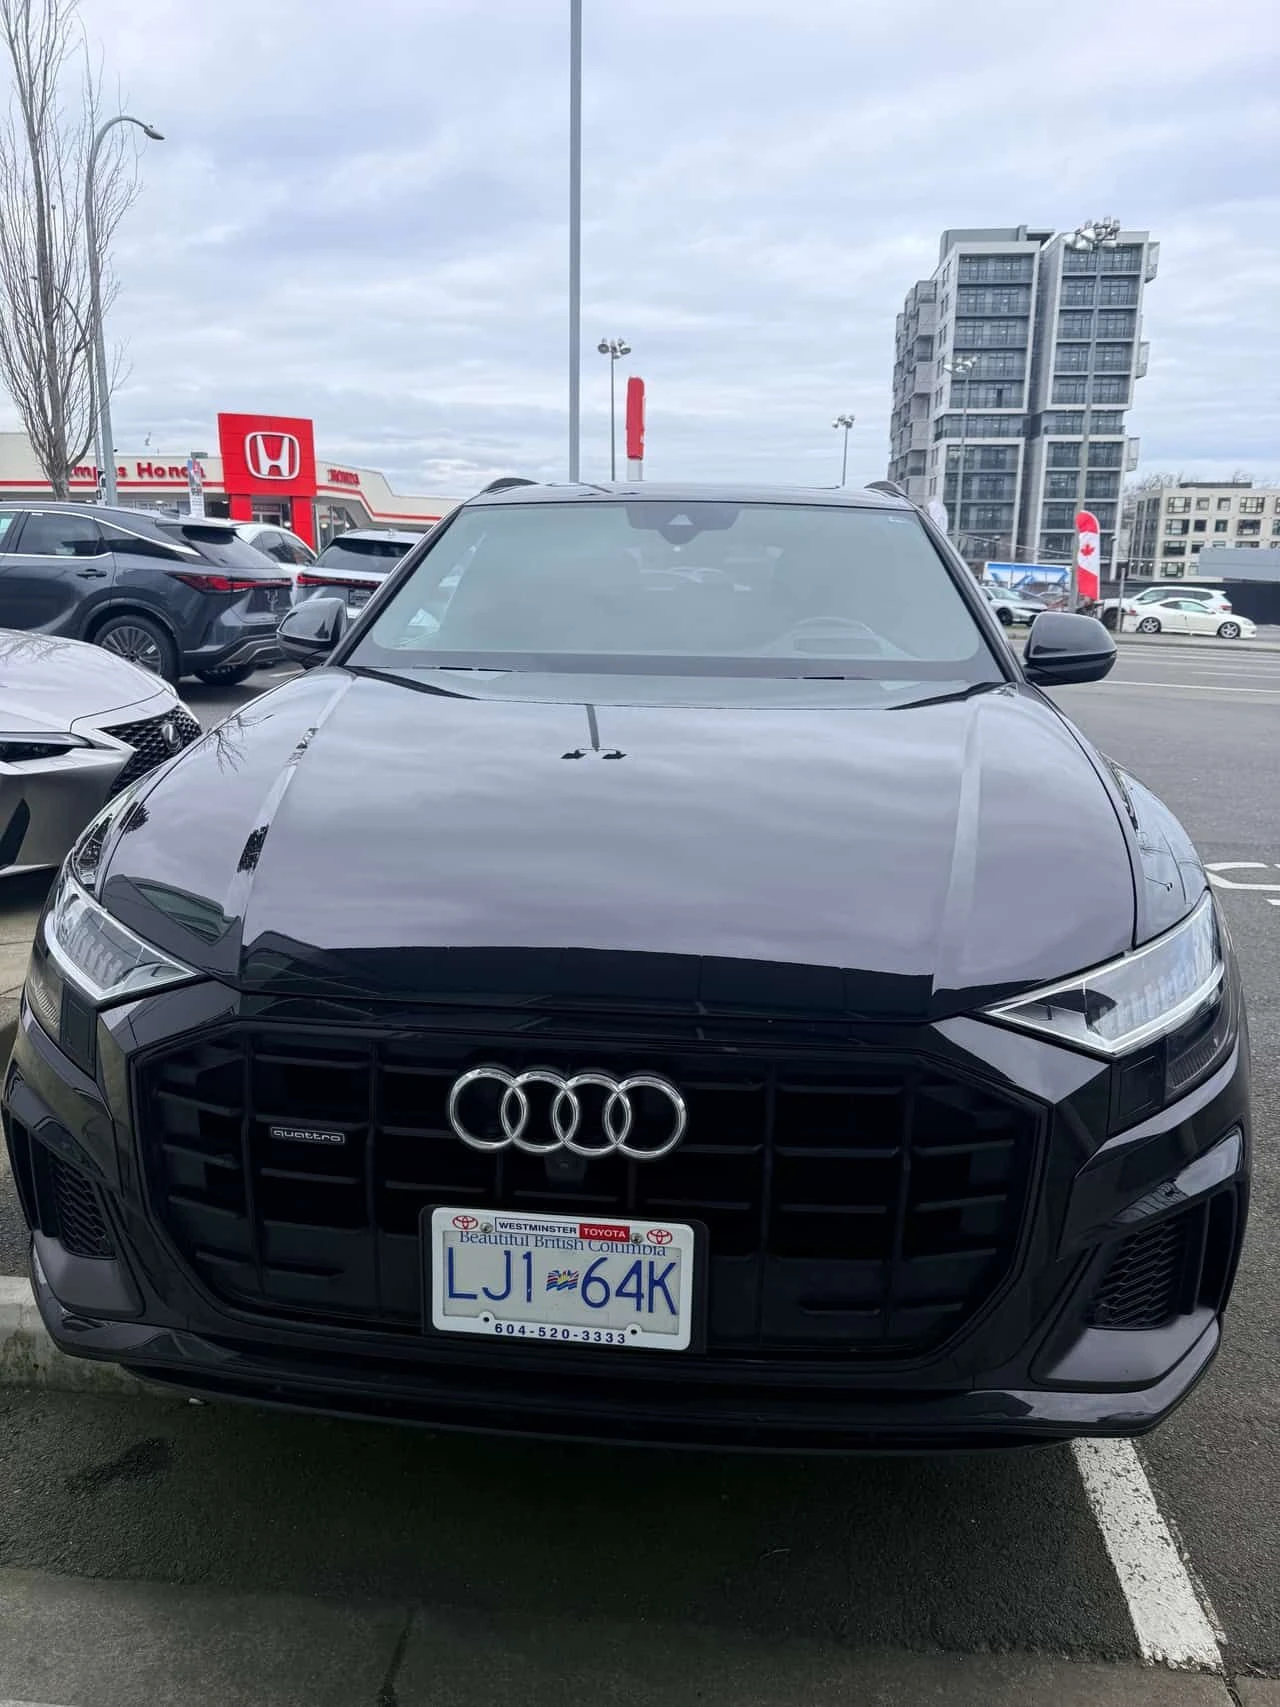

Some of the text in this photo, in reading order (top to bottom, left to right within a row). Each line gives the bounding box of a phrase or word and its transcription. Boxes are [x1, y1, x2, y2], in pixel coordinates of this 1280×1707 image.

[273, 1130, 341, 1142] quattro
[499, 1222, 626, 1238] WESTMINSTER TOYOTA
[460, 1231, 666, 1257] Beautiful British Columbia
[448, 1247, 678, 1316] LJ1 64K
[494, 1323, 625, 1344] 604-520-3333
